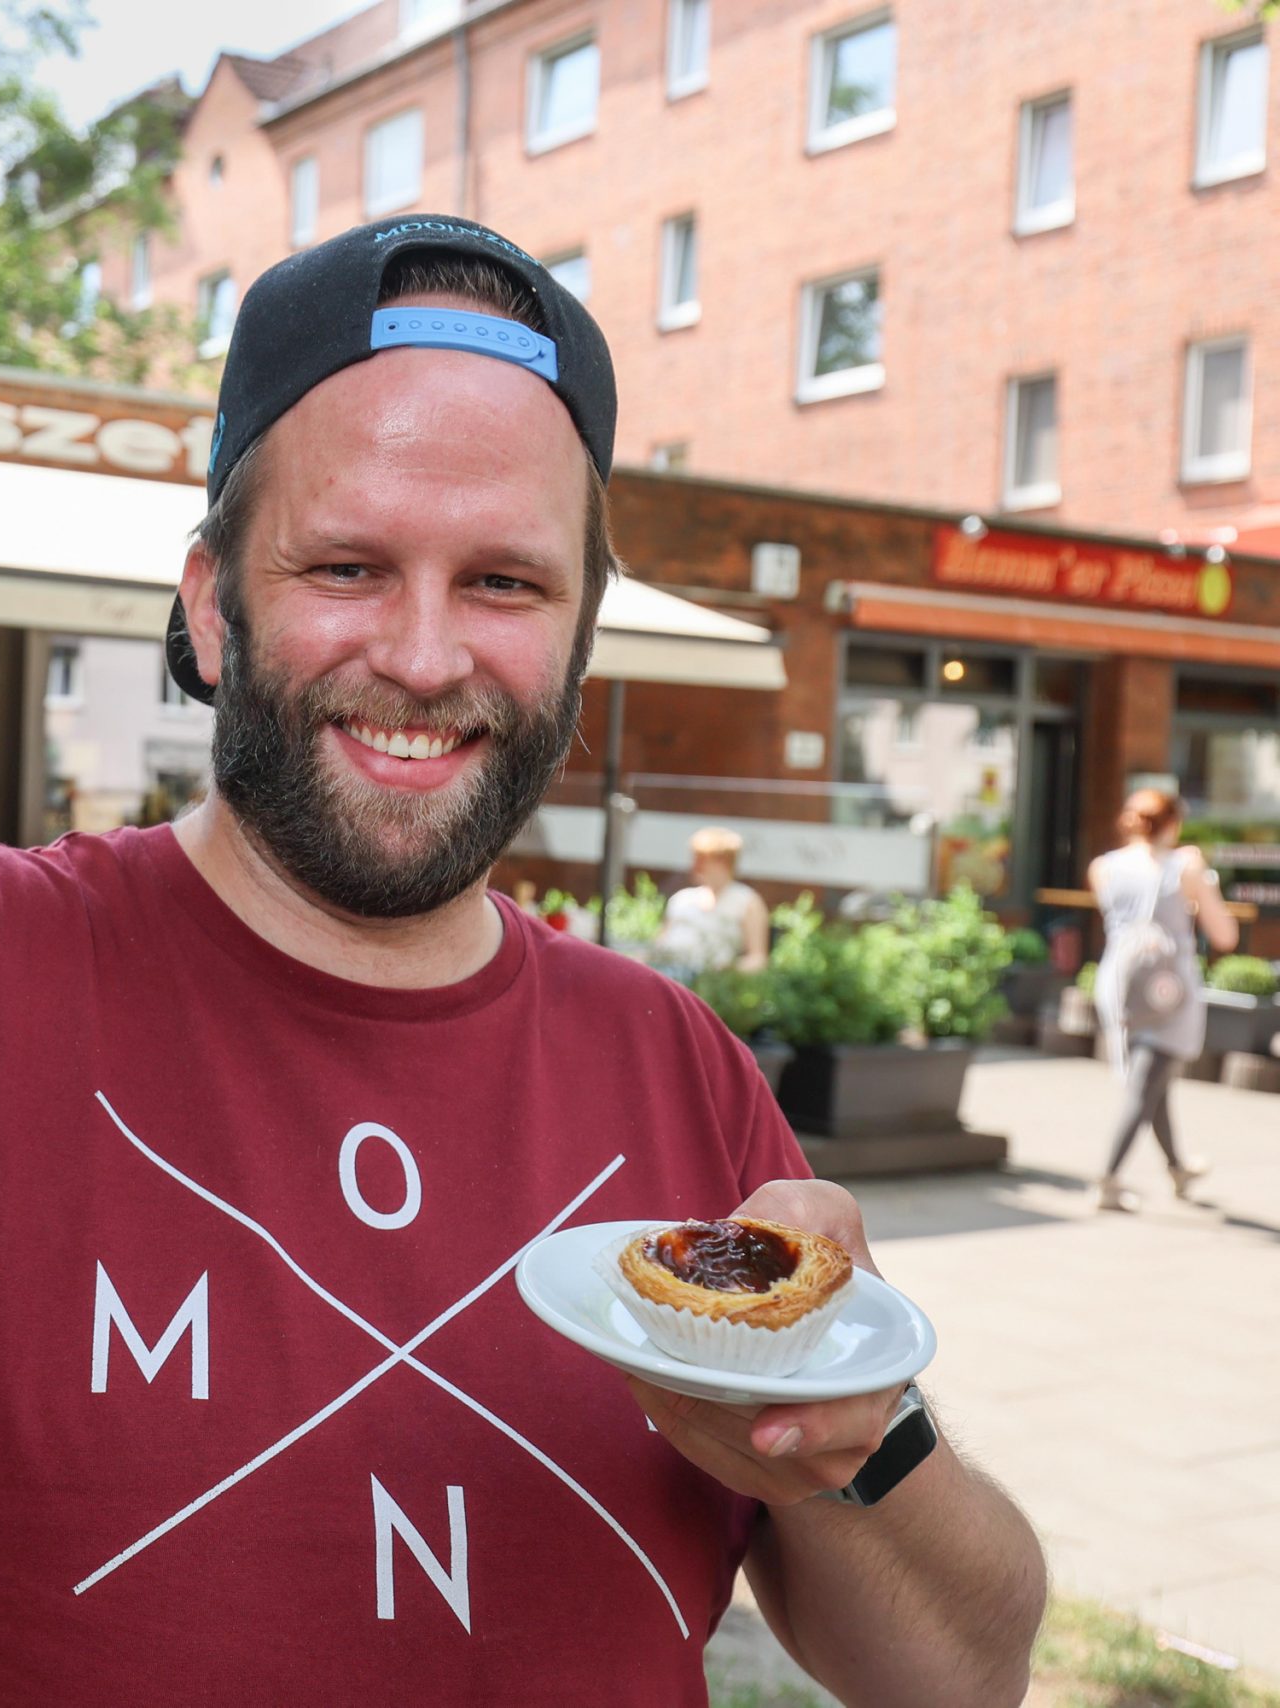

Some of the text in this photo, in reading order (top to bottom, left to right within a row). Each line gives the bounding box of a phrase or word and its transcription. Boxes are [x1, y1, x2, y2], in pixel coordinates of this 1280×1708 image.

[338, 1121, 422, 1230] O
[91, 1259, 209, 1400] M
[371, 1472, 471, 1635] N
